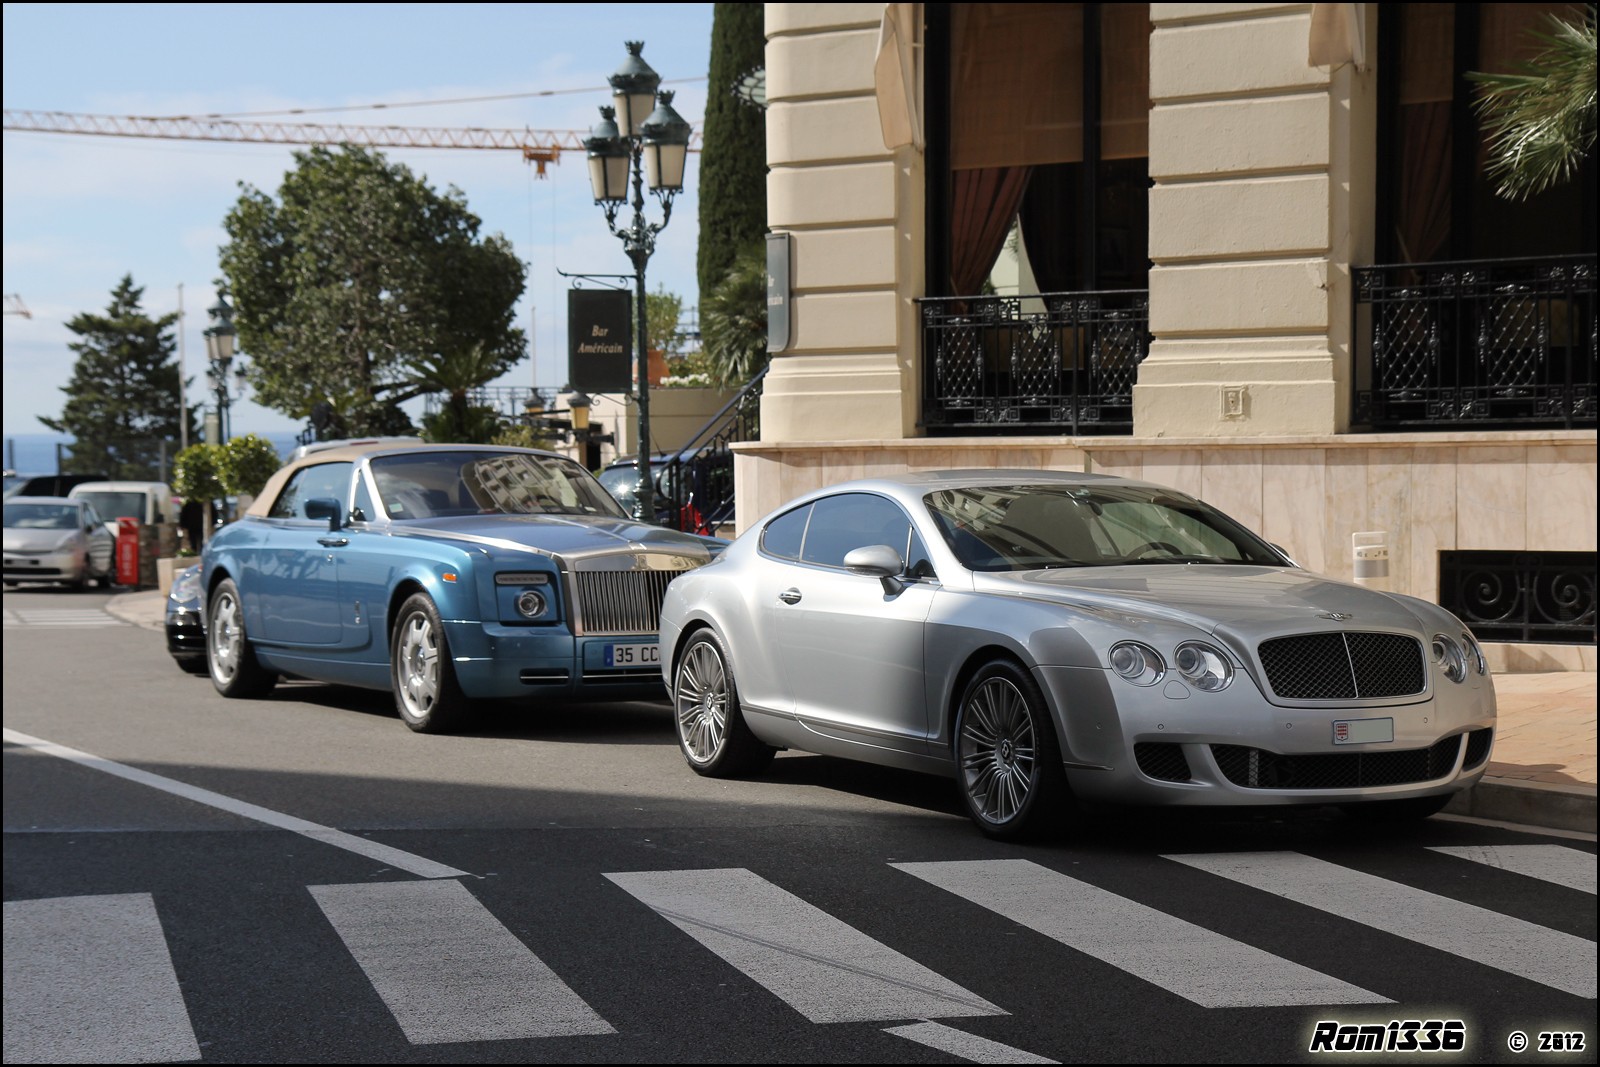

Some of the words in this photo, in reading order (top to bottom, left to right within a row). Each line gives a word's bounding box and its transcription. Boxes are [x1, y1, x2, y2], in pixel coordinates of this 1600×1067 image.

[591, 324, 609, 337] Bar
[577, 341, 623, 354] Américain
[615, 647, 633, 663] 35
[641, 646, 661, 662] CC
